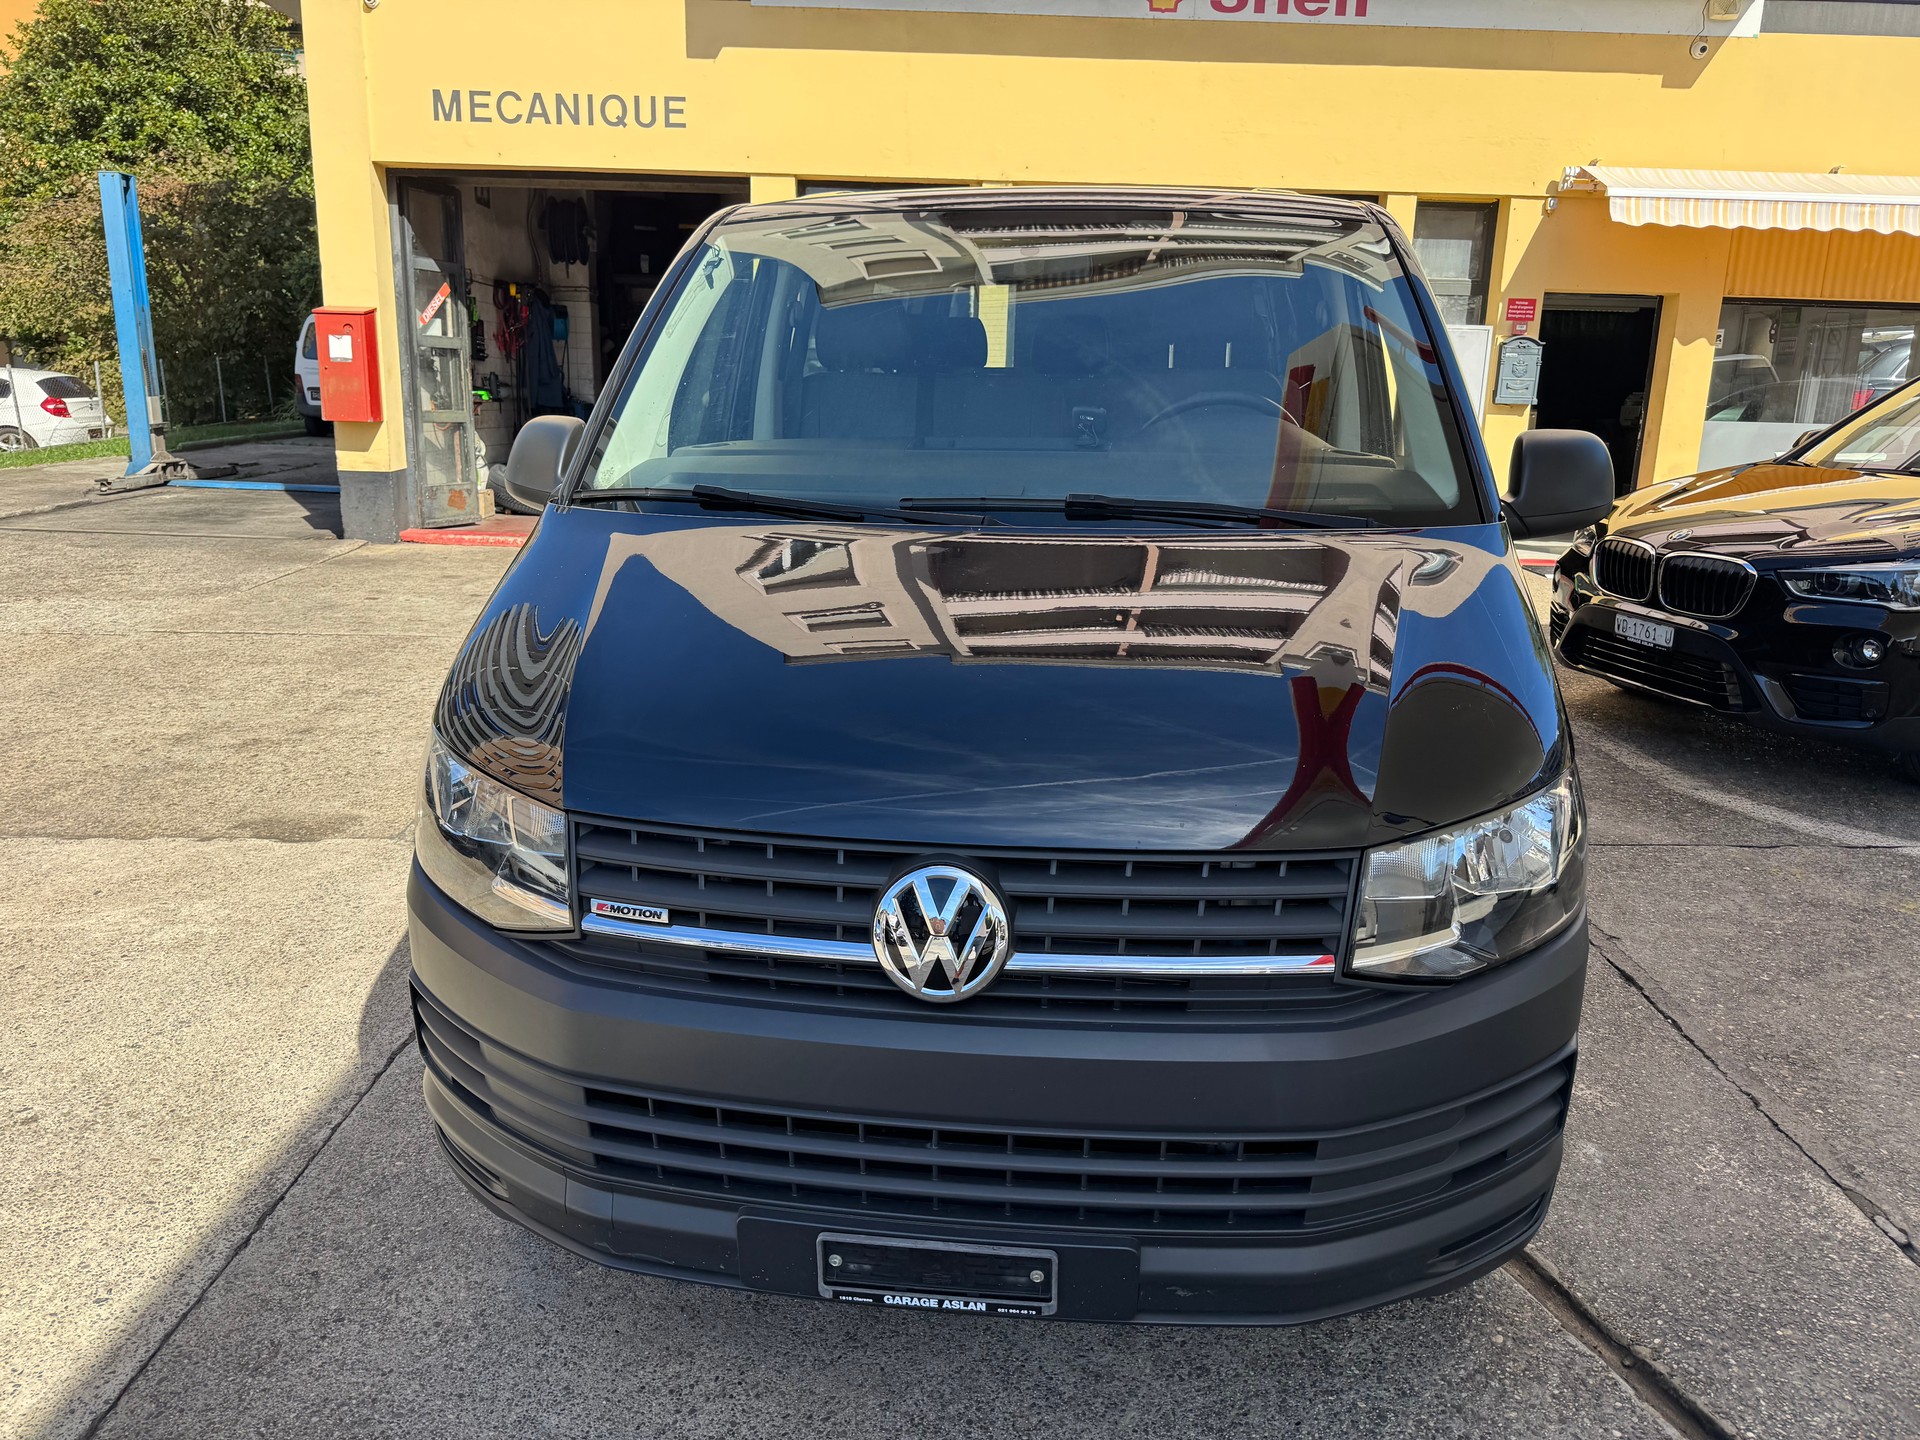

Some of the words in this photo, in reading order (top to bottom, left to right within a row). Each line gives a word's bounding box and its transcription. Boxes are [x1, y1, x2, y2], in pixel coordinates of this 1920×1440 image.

[432, 88, 688, 129] MECANIQUE
[422, 291, 446, 323] DIESEL
[883, 1295, 939, 1308] GARAGE
[942, 1300, 986, 1311] ASLAN
